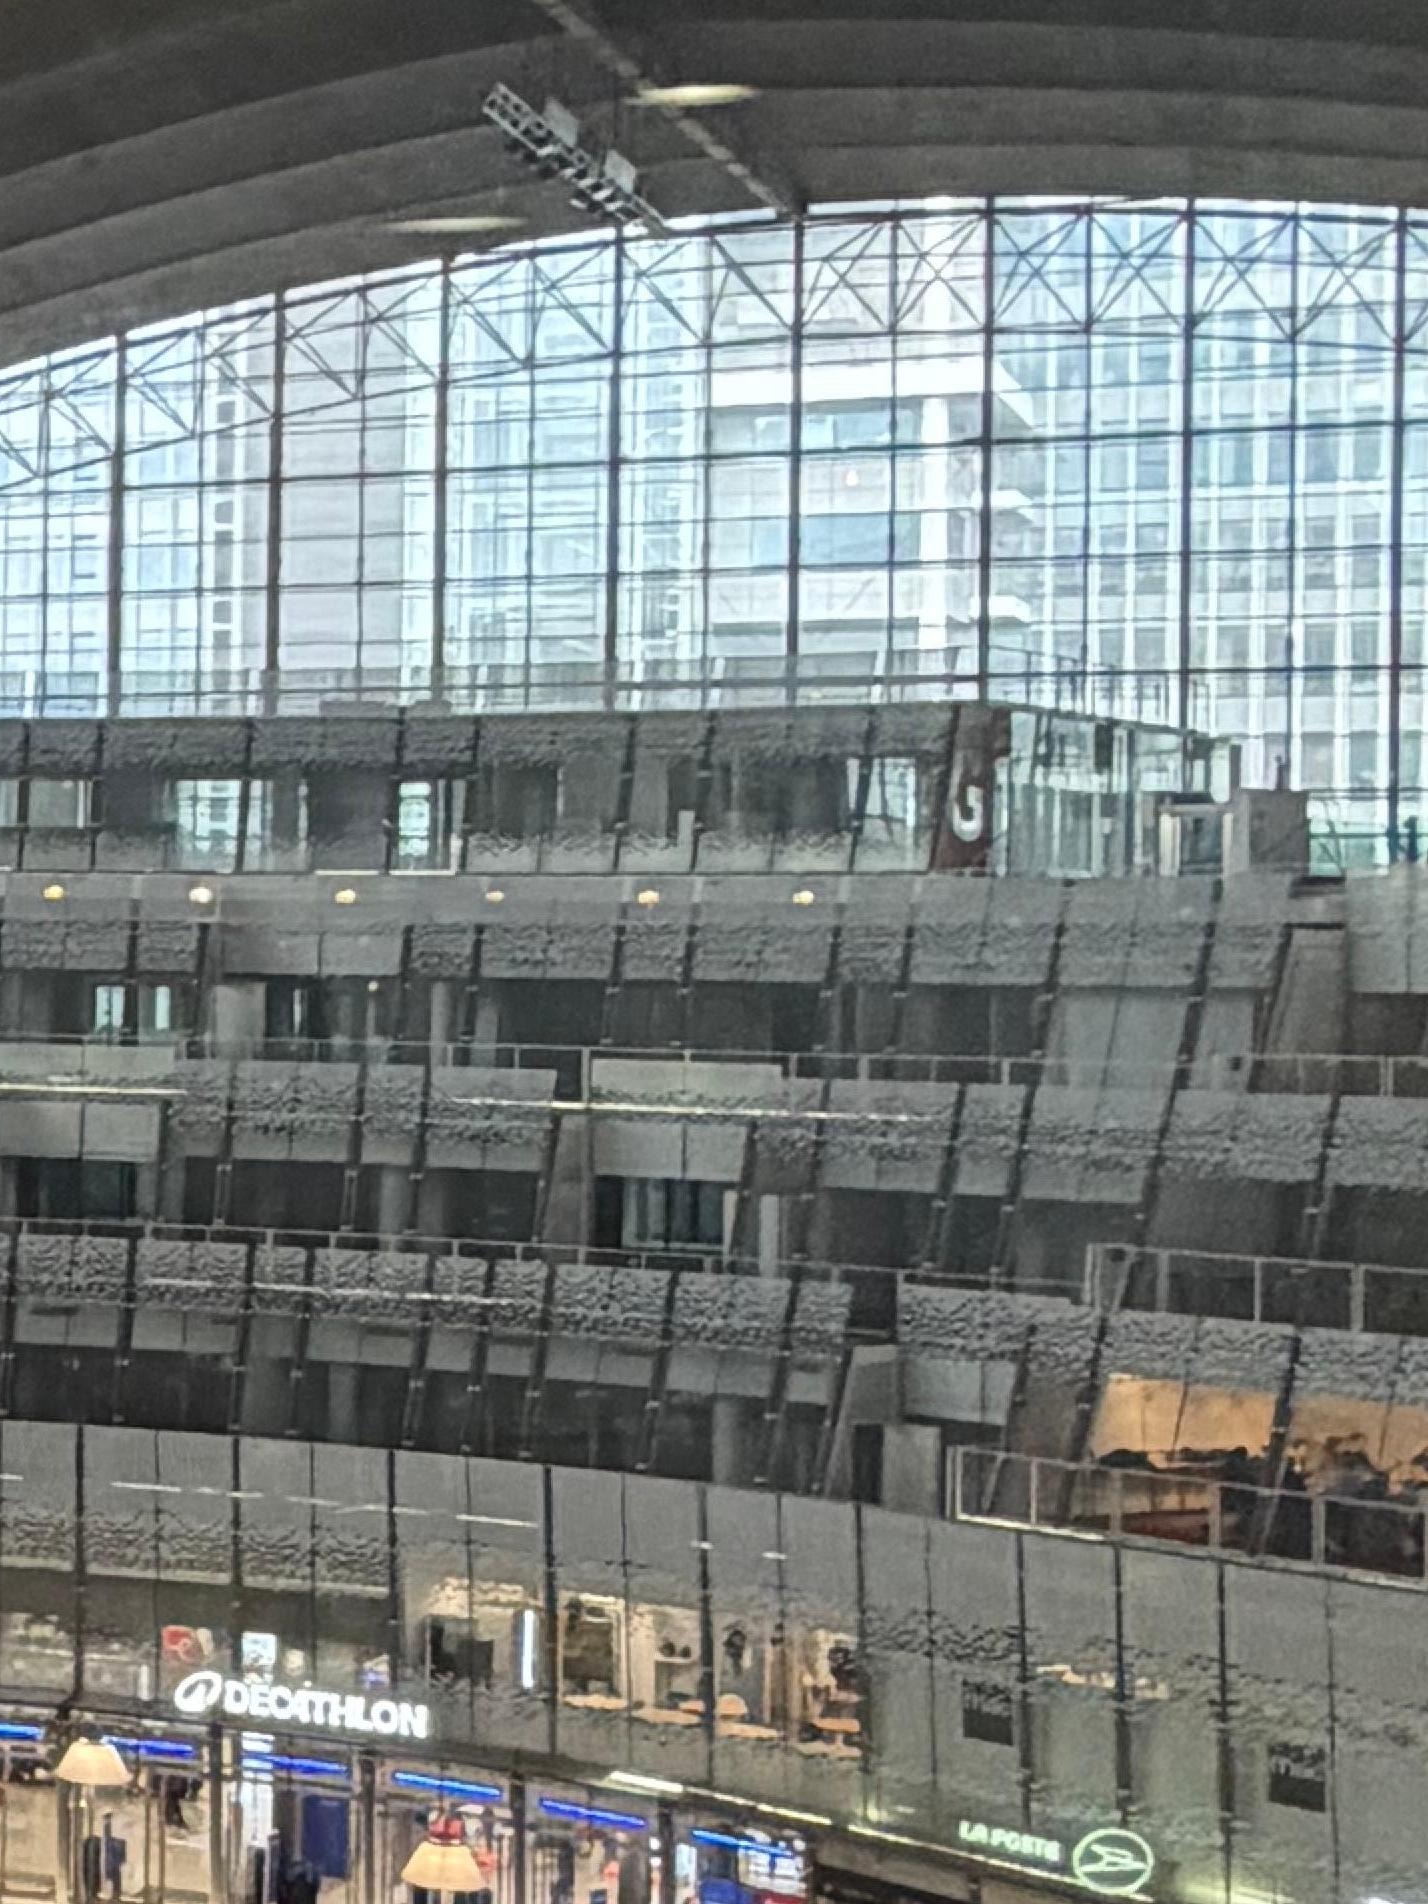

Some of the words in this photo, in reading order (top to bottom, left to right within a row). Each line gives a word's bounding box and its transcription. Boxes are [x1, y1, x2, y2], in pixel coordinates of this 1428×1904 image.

[223, 1680, 429, 1739] DECATHLON
[959, 1820, 988, 1844] LA
[991, 1828, 1061, 1862] POSTE
